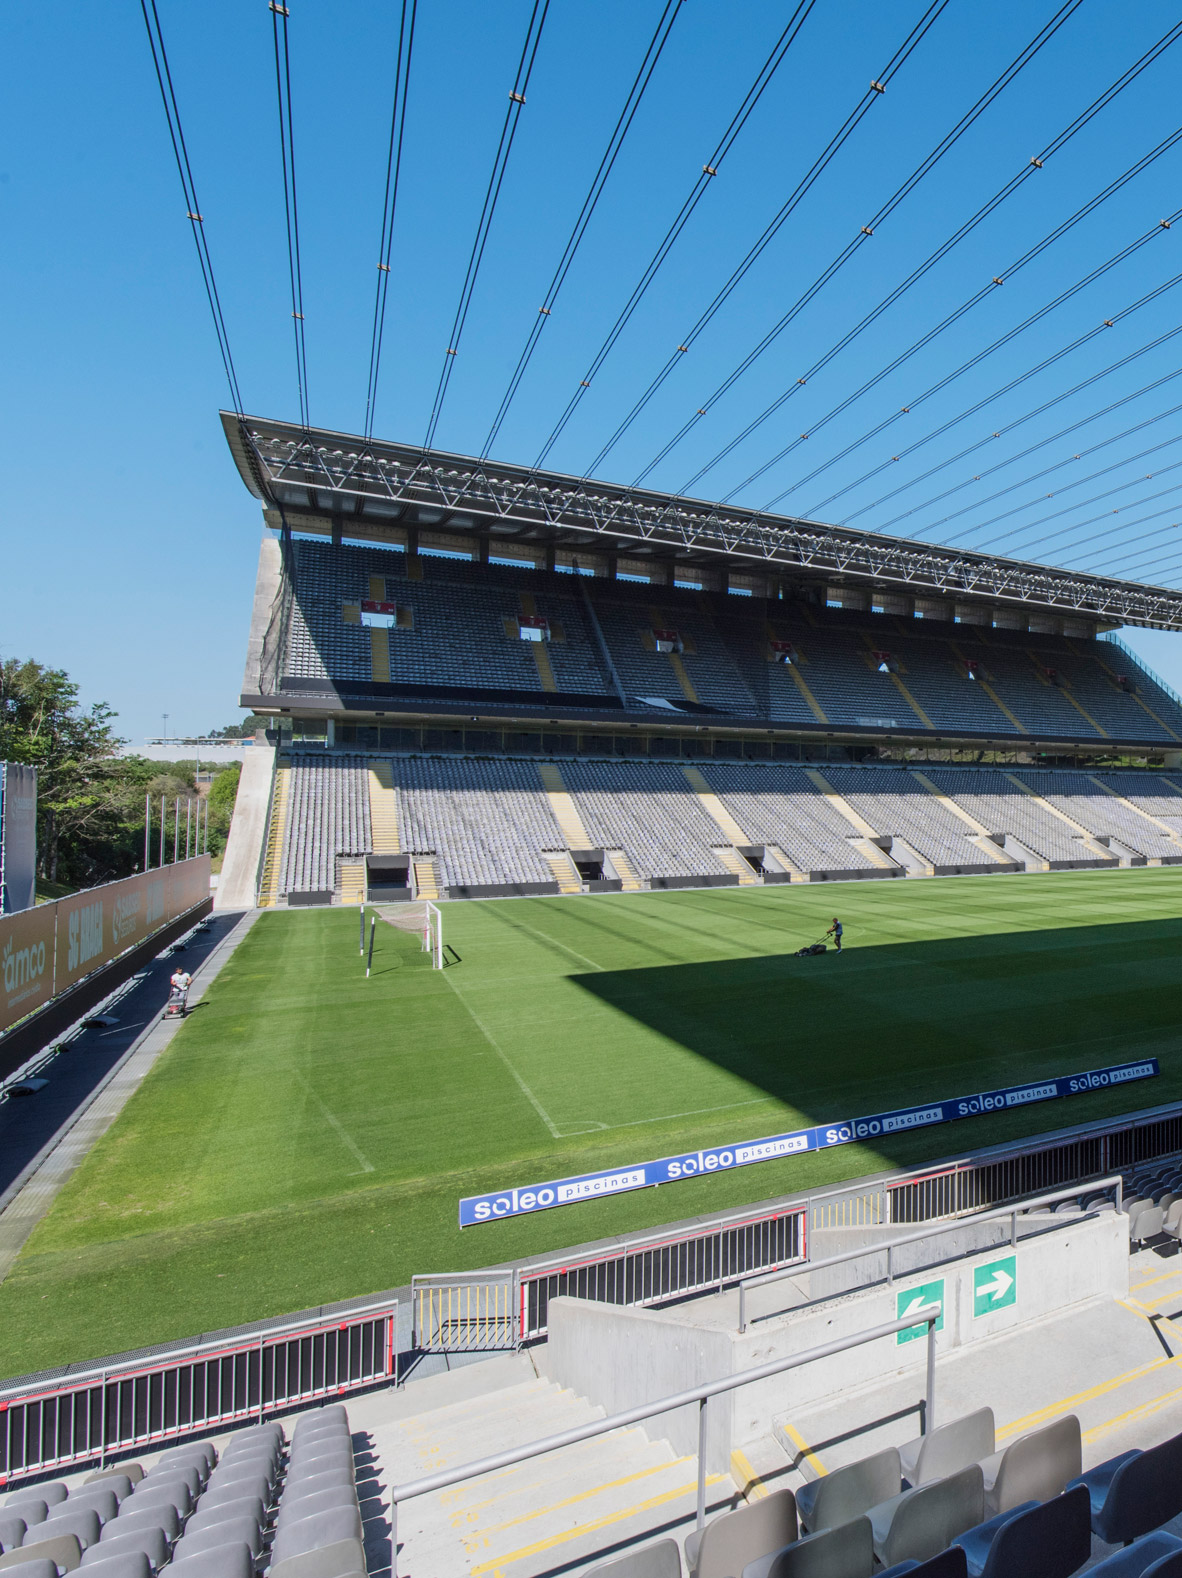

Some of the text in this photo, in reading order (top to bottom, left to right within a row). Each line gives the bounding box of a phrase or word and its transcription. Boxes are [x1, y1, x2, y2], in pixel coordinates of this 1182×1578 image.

[68, 910, 79, 972] SC
[4, 940, 46, 993] amco
[1070, 1066, 1151, 1092] soleo piscinas
[958, 1087, 1054, 1115] soleo piscinas
[826, 1111, 938, 1144] soleo piscinas
[667, 1140, 802, 1178] soleo piscinas
[474, 1174, 638, 1219] soleo piscinas
